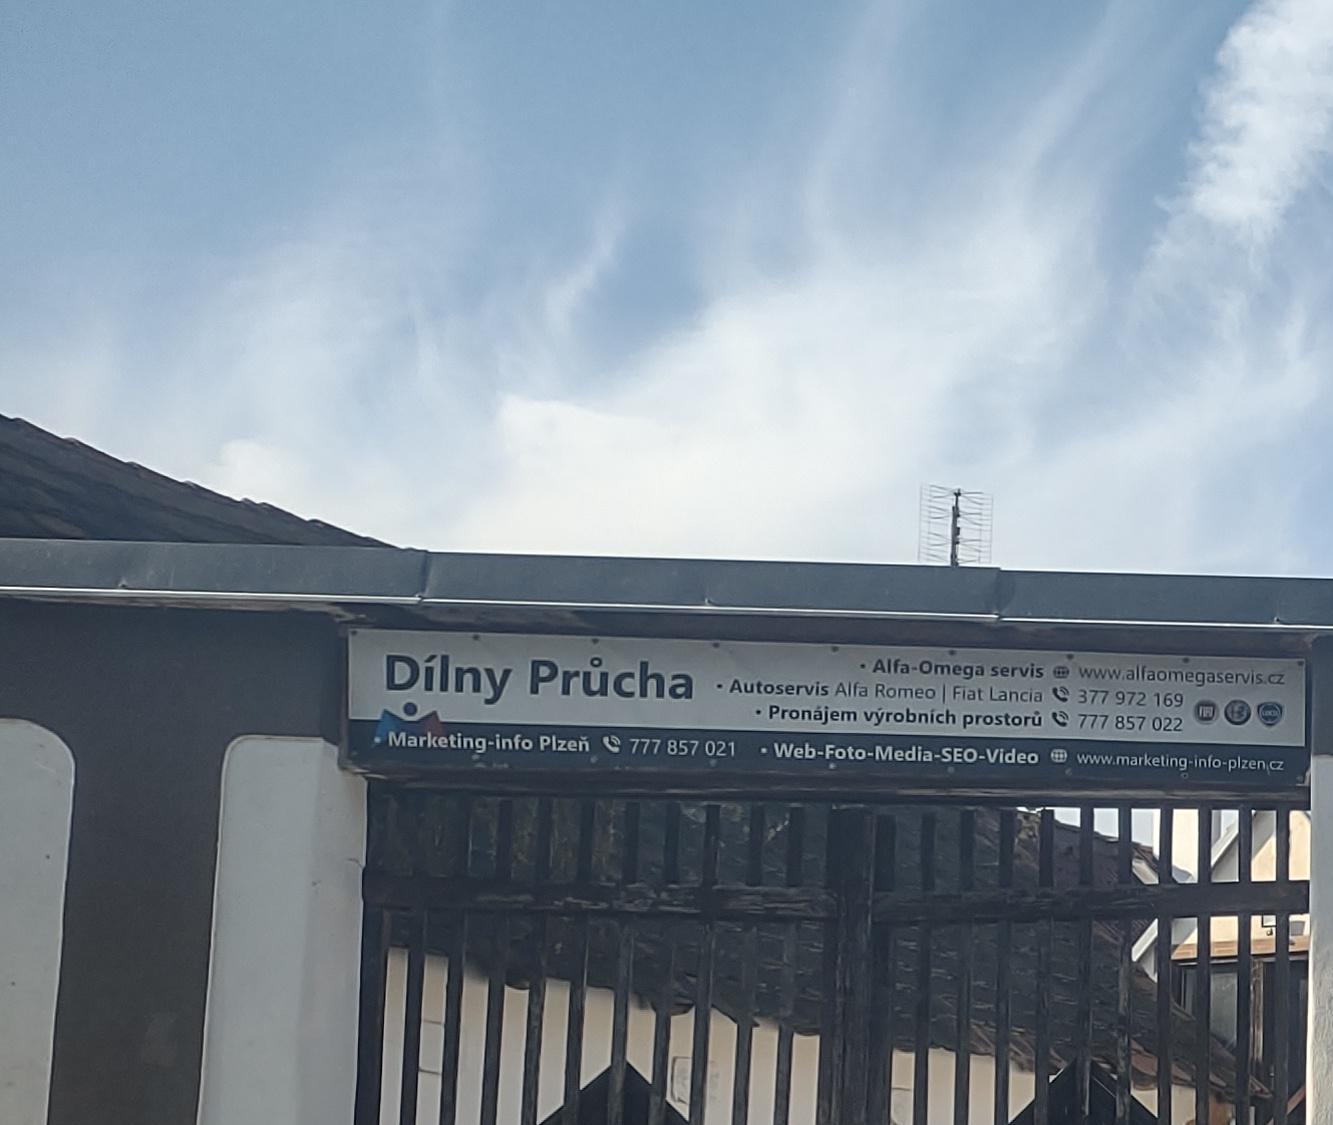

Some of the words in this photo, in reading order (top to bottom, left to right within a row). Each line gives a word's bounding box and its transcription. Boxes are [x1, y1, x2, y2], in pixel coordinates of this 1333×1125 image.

[385, 654, 512, 705] Dílny
[529, 656, 694, 700] Průcha
[872, 659, 985, 680] Alfa-Omega
[990, 663, 1044, 679] servis
[1078, 666, 1286, 687] www.alfaomegaservis.cz
[729, 678, 829, 697] Autoservis
[835, 681, 869, 698] Alfa
[875, 683, 936, 700] Romeo
[952, 685, 983, 701] Fiat
[990, 686, 1043, 703] Lancia
[1077, 689, 1109, 705] 377
[1115, 691, 1146, 706] 972
[1153, 693, 1184, 708] 169
[768, 705, 858, 725] Pronájem
[863, 707, 956, 727] výrobních
[962, 711, 1043, 730] prostorů
[1077, 714, 1109, 730] 777
[1115, 715, 1146, 731] 857
[1152, 717, 1183, 732] 022
[388, 731, 533, 753] Marketing-info
[539, 735, 590, 752] Plzeň
[629, 738, 662, 755] 777
[667, 740, 699, 756] 857
[705, 741, 735, 756] 021
[774, 742, 1039, 764] Web-Foto-Media-SEO-Video
[1076, 753, 1284, 771] www.marketing-info-plzen.cz
